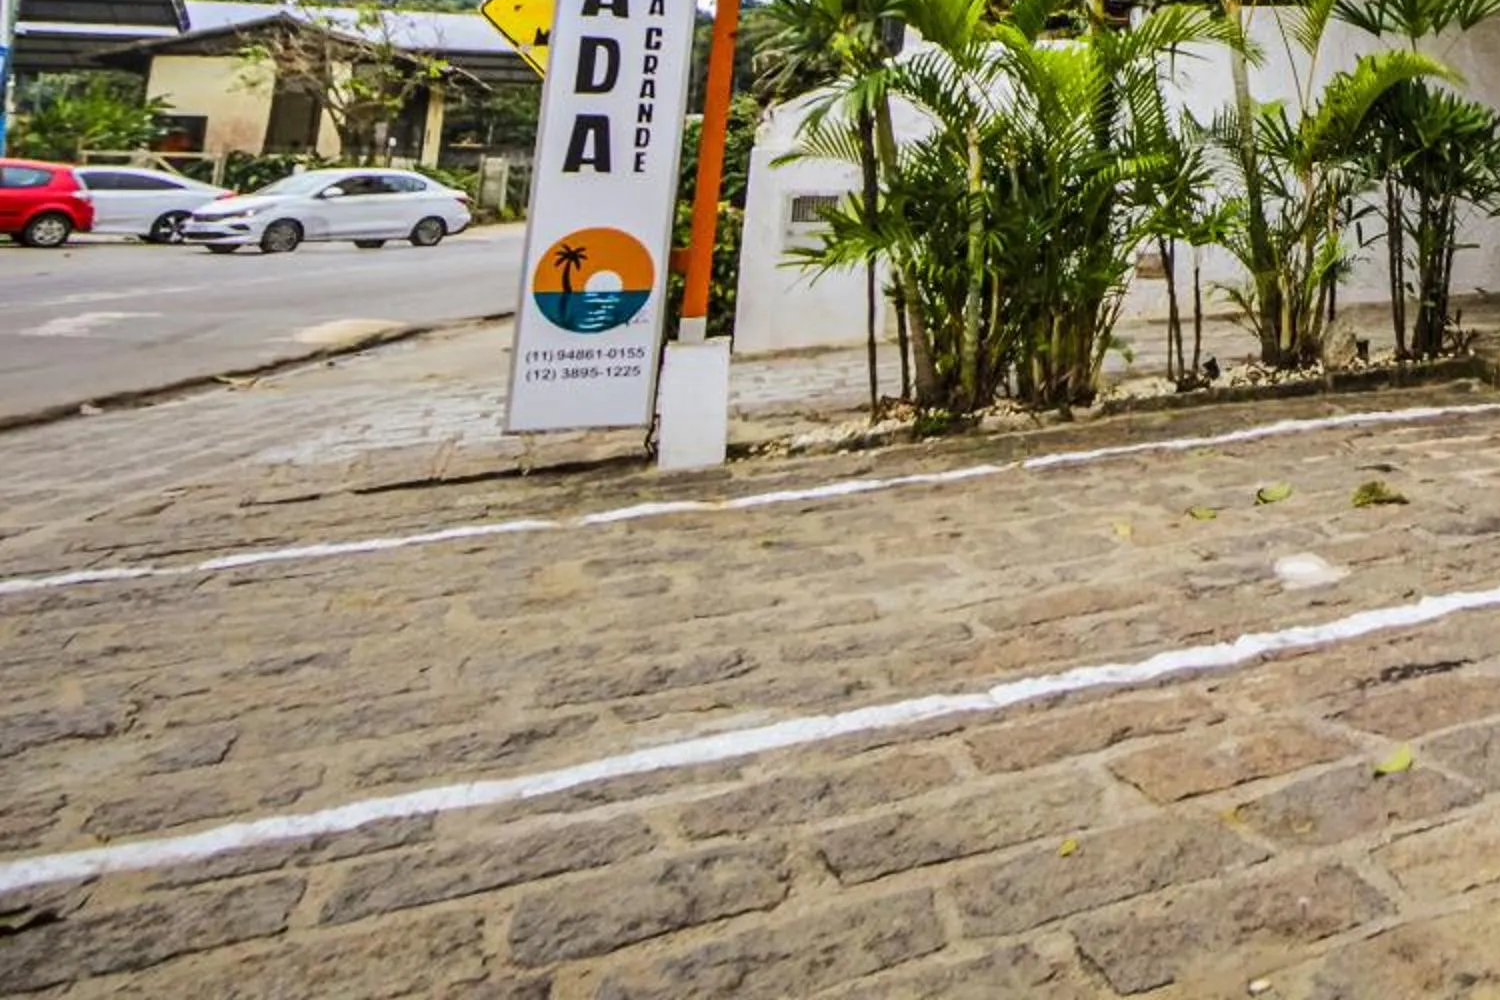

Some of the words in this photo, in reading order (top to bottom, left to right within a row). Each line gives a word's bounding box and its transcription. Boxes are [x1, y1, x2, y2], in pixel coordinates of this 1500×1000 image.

[525, 351, 553, 364] (11)
[525, 368, 557, 382] (12)
[560, 365, 641, 379] 3895-1225
